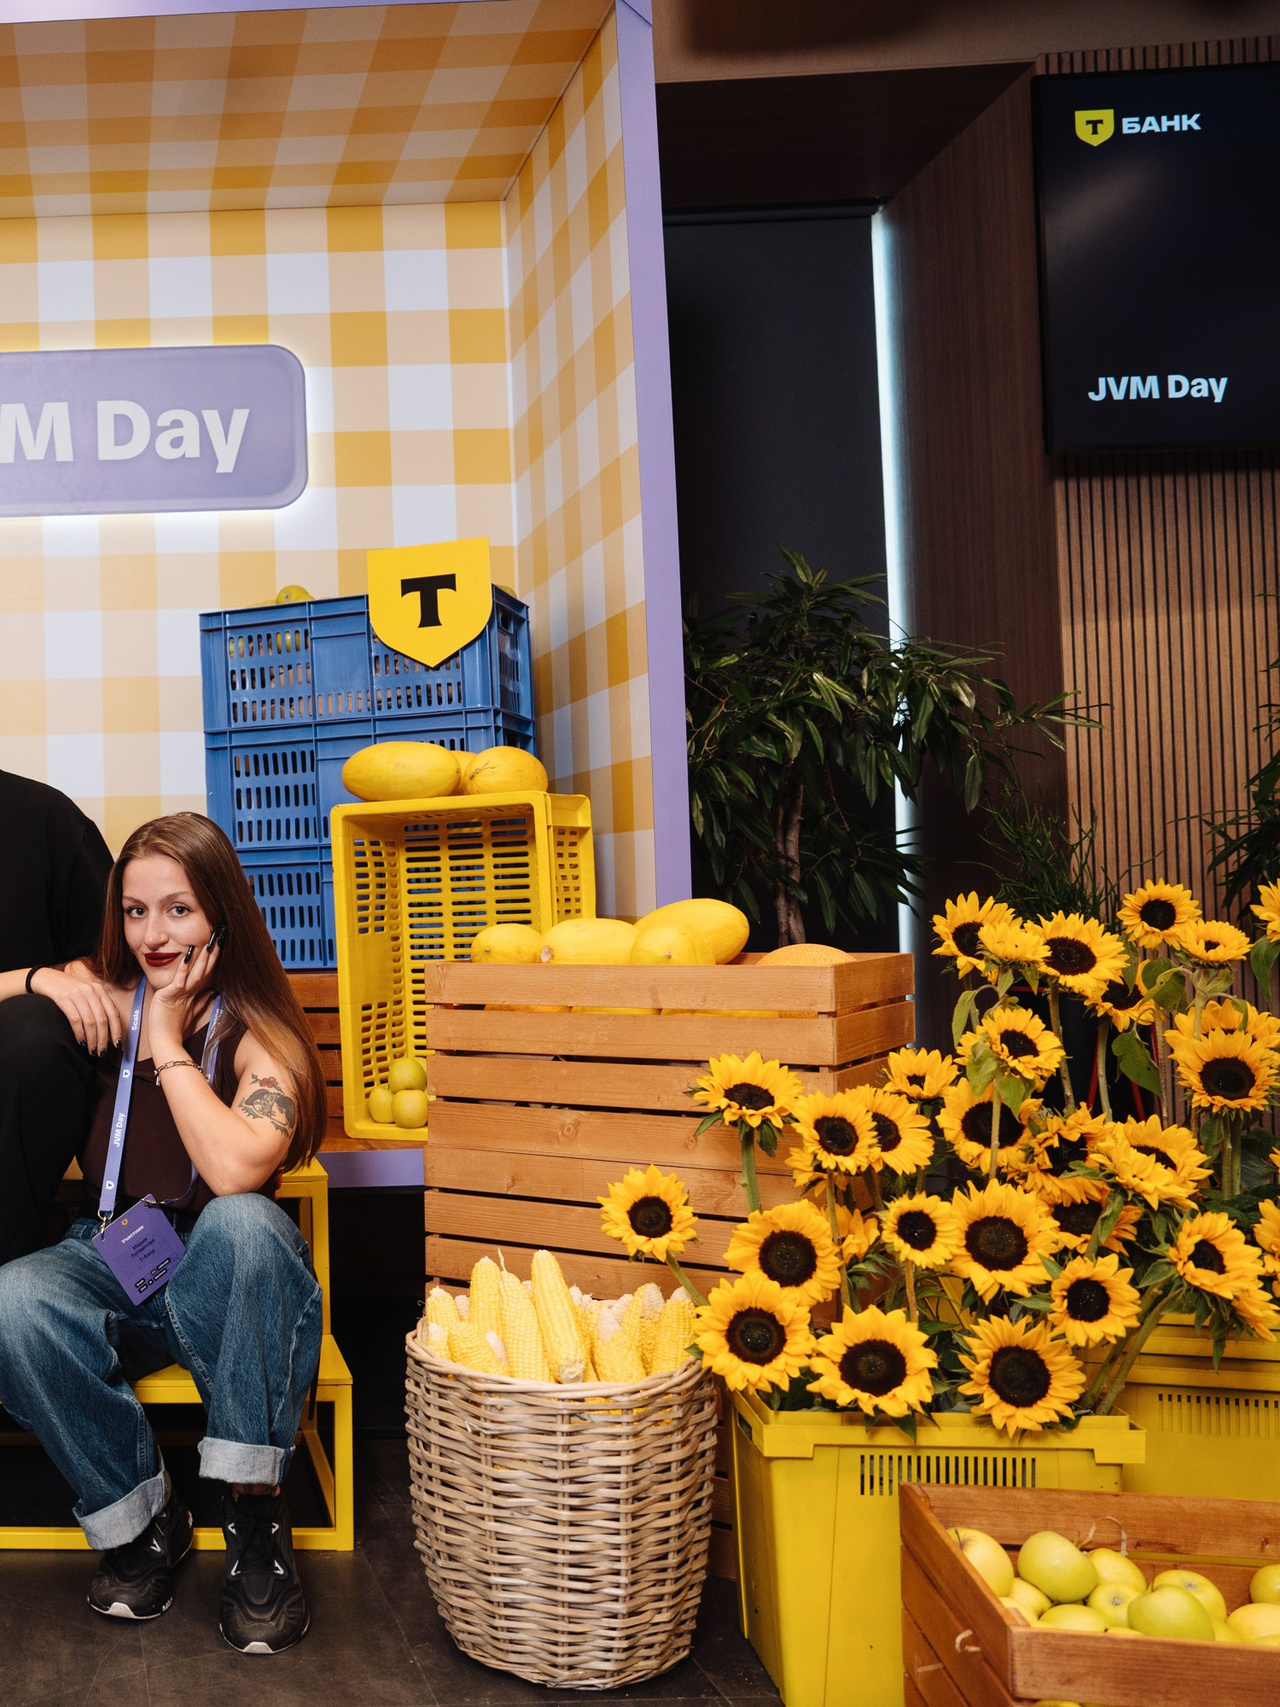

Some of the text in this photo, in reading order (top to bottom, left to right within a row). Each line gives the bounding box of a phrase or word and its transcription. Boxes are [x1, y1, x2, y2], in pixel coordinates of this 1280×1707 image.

[1122, 113, 1202, 134] БАНК
[1088, 374, 1228, 403] JVM Day
[97, 400, 250, 473] Day
[131, 1009, 140, 1031] Scala
[113, 1112, 126, 1148] JVM Day
